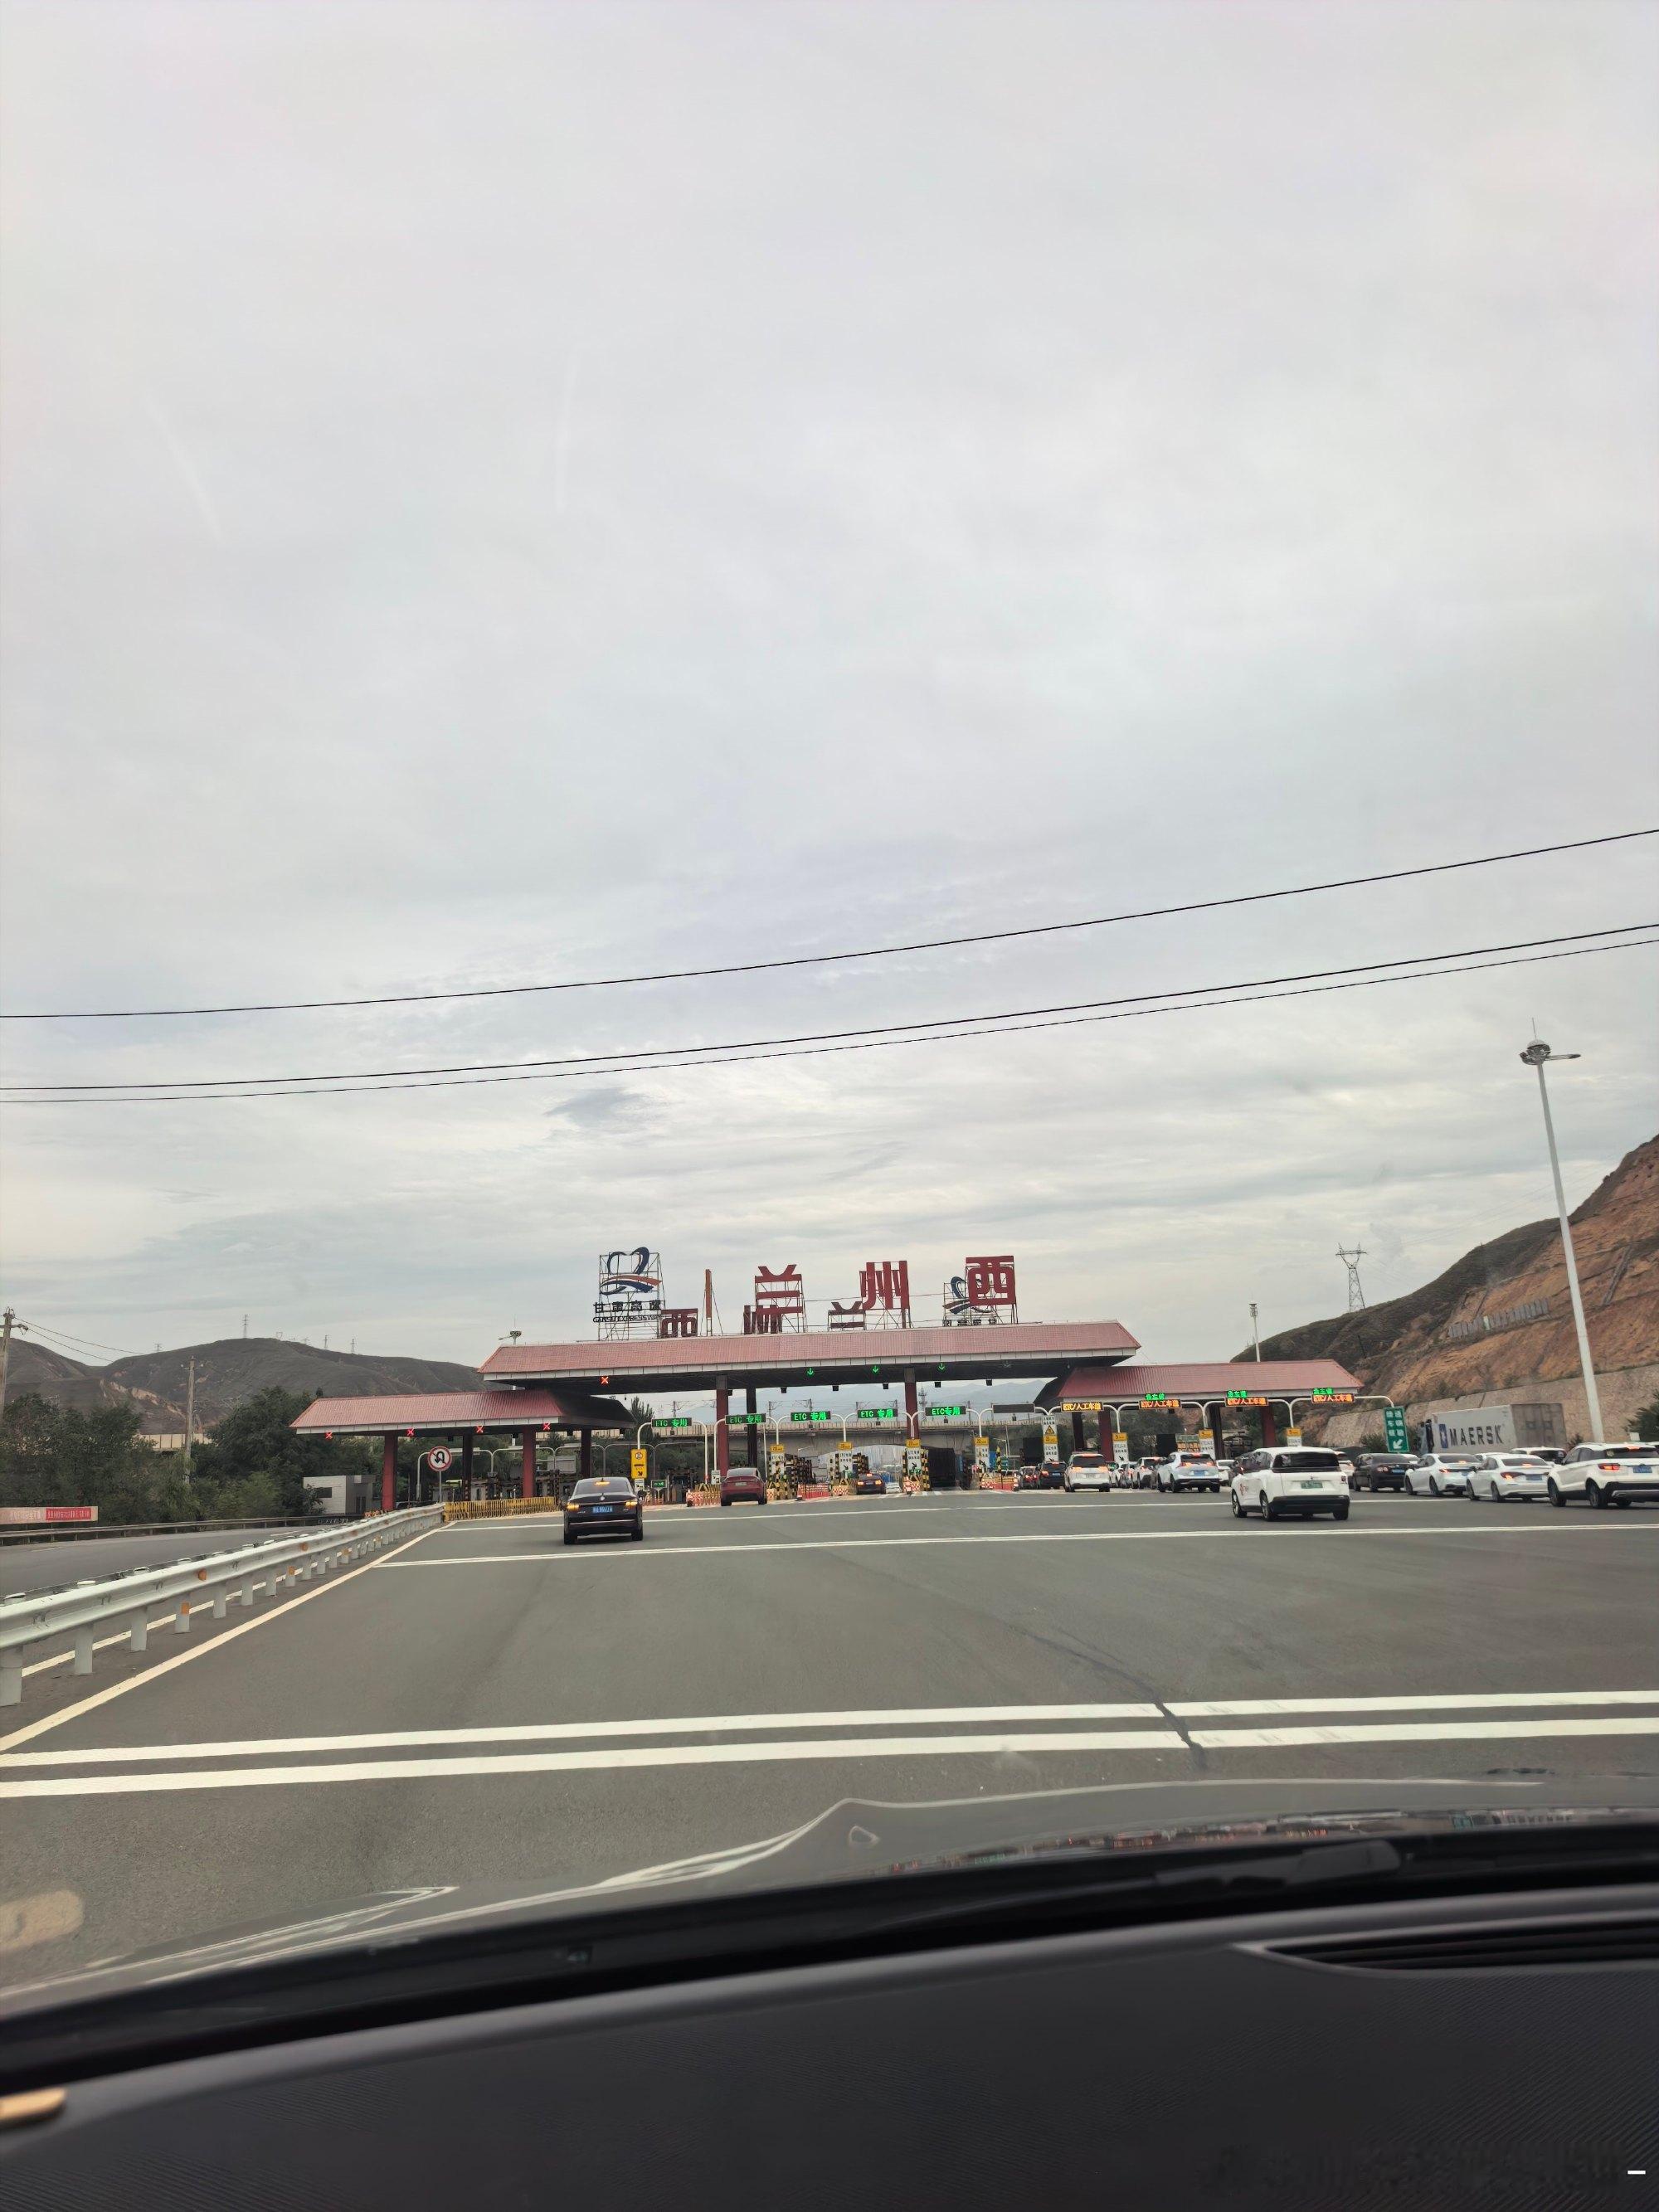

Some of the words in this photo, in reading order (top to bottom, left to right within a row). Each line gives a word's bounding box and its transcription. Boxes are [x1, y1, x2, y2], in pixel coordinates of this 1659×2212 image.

[755, 1256, 1016, 1315] 兰州西
[1449, 1424, 1504, 1446] MAERSK
